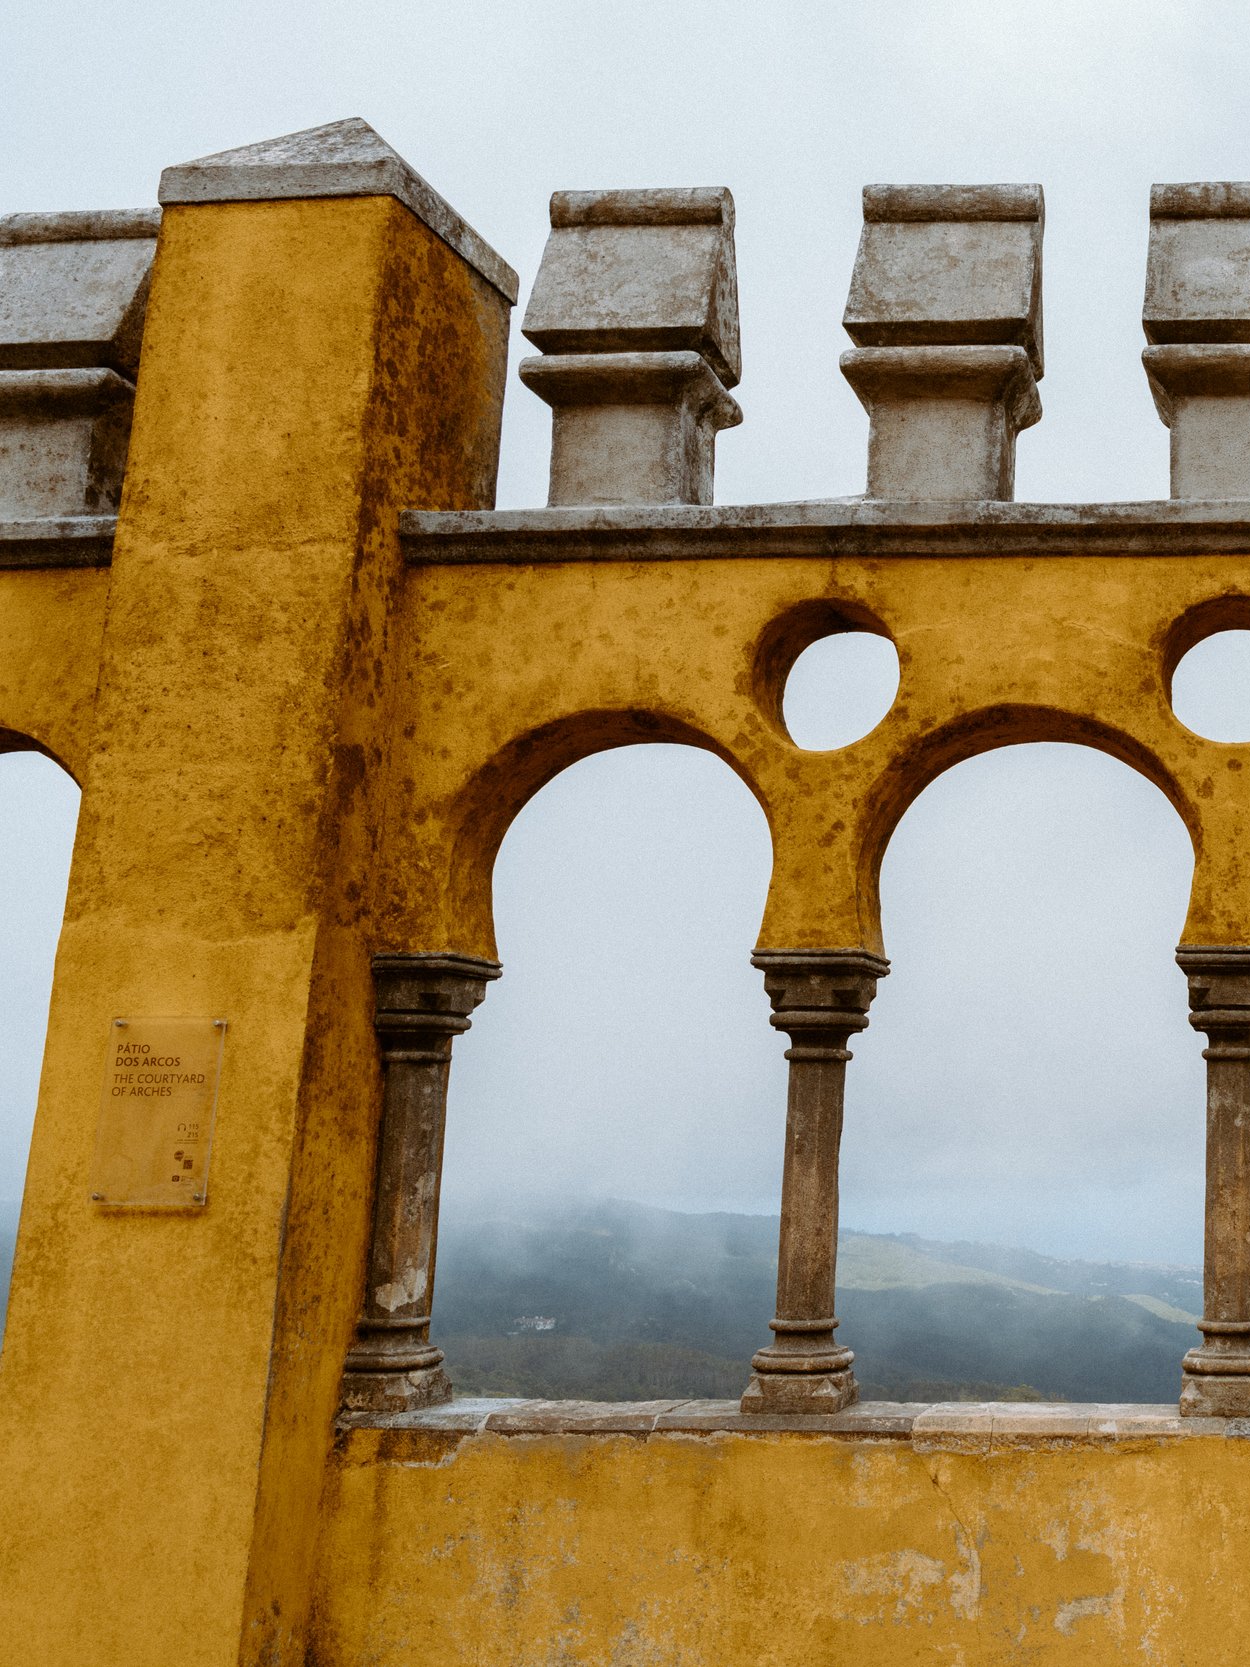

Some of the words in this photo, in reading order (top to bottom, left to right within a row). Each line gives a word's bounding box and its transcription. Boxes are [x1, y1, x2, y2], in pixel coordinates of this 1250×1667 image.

[117, 1042, 151, 1054] PÁTIO
[115, 1057, 139, 1067] DOS
[141, 1057, 181, 1067] ARCOS
[114, 1073, 134, 1084] THE
[137, 1073, 205, 1084] COURTYARD
[111, 1086, 126, 1097] OF
[129, 1086, 172, 1097] ARCHES
